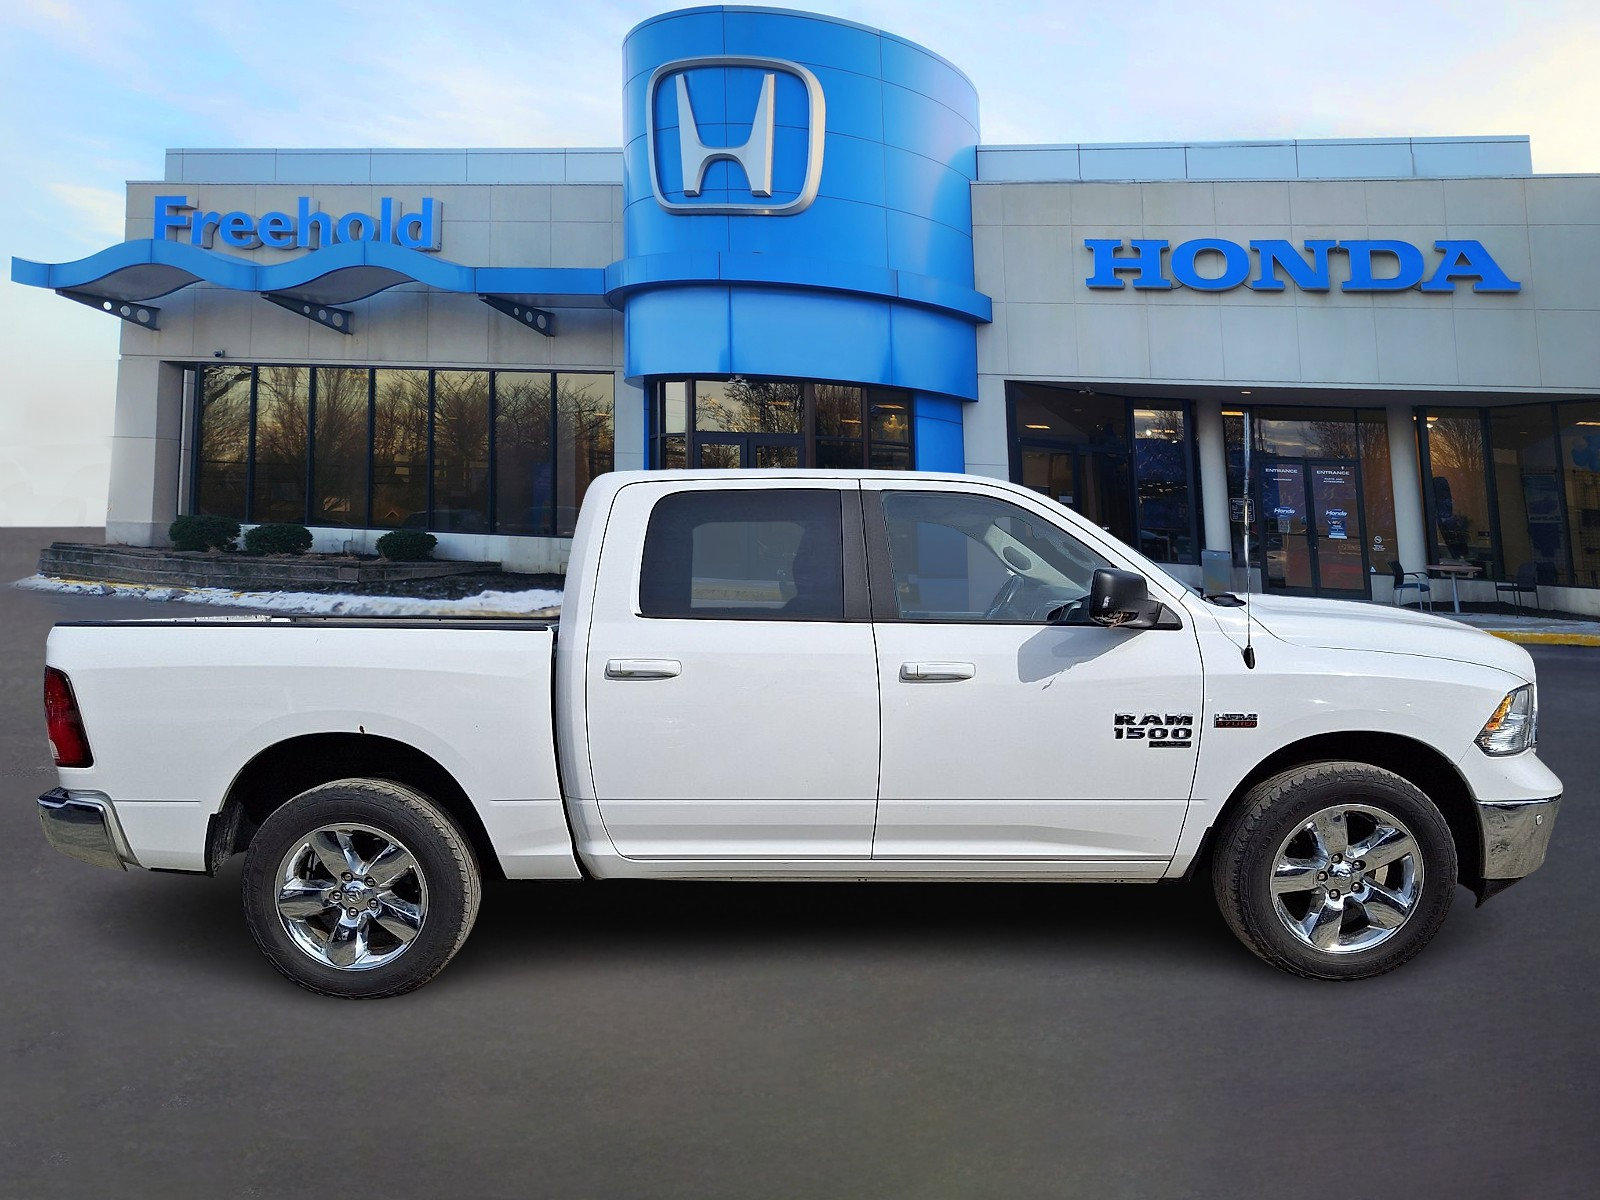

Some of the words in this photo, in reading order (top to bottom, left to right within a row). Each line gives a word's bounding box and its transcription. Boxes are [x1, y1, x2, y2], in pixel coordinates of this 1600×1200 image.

[154, 195, 438, 250] Freehold
[1084, 238, 1521, 292] HONDA
[1113, 727, 1193, 740] 1500
[1114, 713, 1193, 726] RAM
